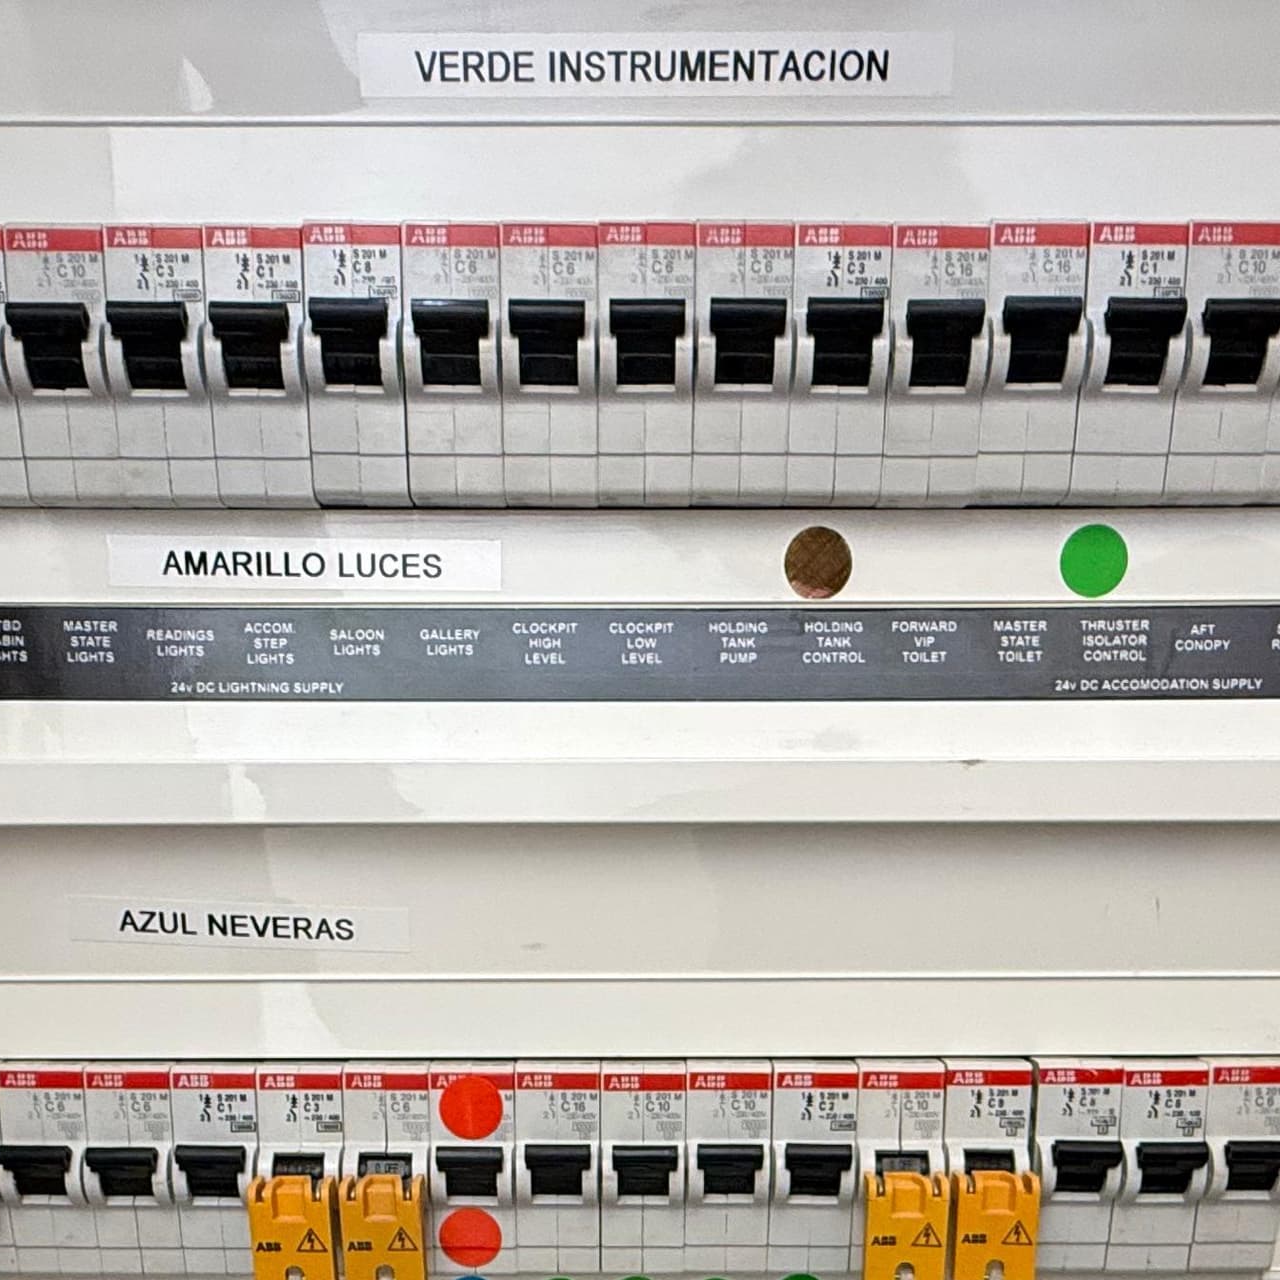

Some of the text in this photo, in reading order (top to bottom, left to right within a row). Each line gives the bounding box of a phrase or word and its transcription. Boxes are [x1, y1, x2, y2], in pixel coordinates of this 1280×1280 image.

[415, 49, 889, 82] VERDE INSTRUMENTACION
[13, 232, 48, 248] ABB
[114, 230, 149, 245] ABB
[212, 229, 247, 245] ABB
[509, 227, 545, 244] ABB
[163, 550, 442, 578] AMARILLO LUCES
[63, 620, 118, 632] MASTER
[512, 622, 578, 634] CLOCKPIT
[609, 622, 674, 634] CLOCKPIT
[709, 622, 768, 634] HOLDING
[804, 621, 863, 633] HOLDING
[892, 621, 957, 632] FORWARD
[994, 620, 1047, 632] MASTER
[1080, 619, 1149, 631] THRUSTER
[1190, 624, 1216, 635] AFT
[147, 629, 215, 641] READINGS
[330, 629, 384, 641] SALOON
[420, 629, 480, 640] GALLERY
[1083, 634, 1147, 647] ISOLATOR
[70, 636, 111, 648] STATE
[529, 637, 561, 649] HIGH
[627, 637, 657, 649] LOW
[721, 637, 756, 648] TANK
[816, 636, 851, 647] TANK
[914, 636, 935, 647] VIP
[1001, 635, 1040, 647] STATE
[1175, 639, 1230, 651] CONOPY
[157, 645, 205, 657] LIGHTS
[334, 644, 381, 656] LIGHTS
[427, 644, 473, 656] LIGHTS
[998, 650, 1043, 662] TOILET
[1083, 649, 1146, 662] CONTROL
[67, 651, 114, 663] LIGHTS
[525, 652, 566, 665] LEVEL
[621, 652, 662, 664] LEVEL
[720, 652, 757, 664] PUMP
[802, 651, 865, 663] CONTROL
[902, 651, 947, 663] TOILET
[171, 681, 344, 693] 24v DC LIGHTNING SUPPLY
[120, 910, 354, 940] AZUL NEVERAS
[5, 1073, 36, 1086] ABB
[92, 1074, 123, 1087] ABB
[178, 1075, 209, 1087] ABB
[256, 1242, 282, 1252] ABB
[347, 1241, 373, 1252] ABB
